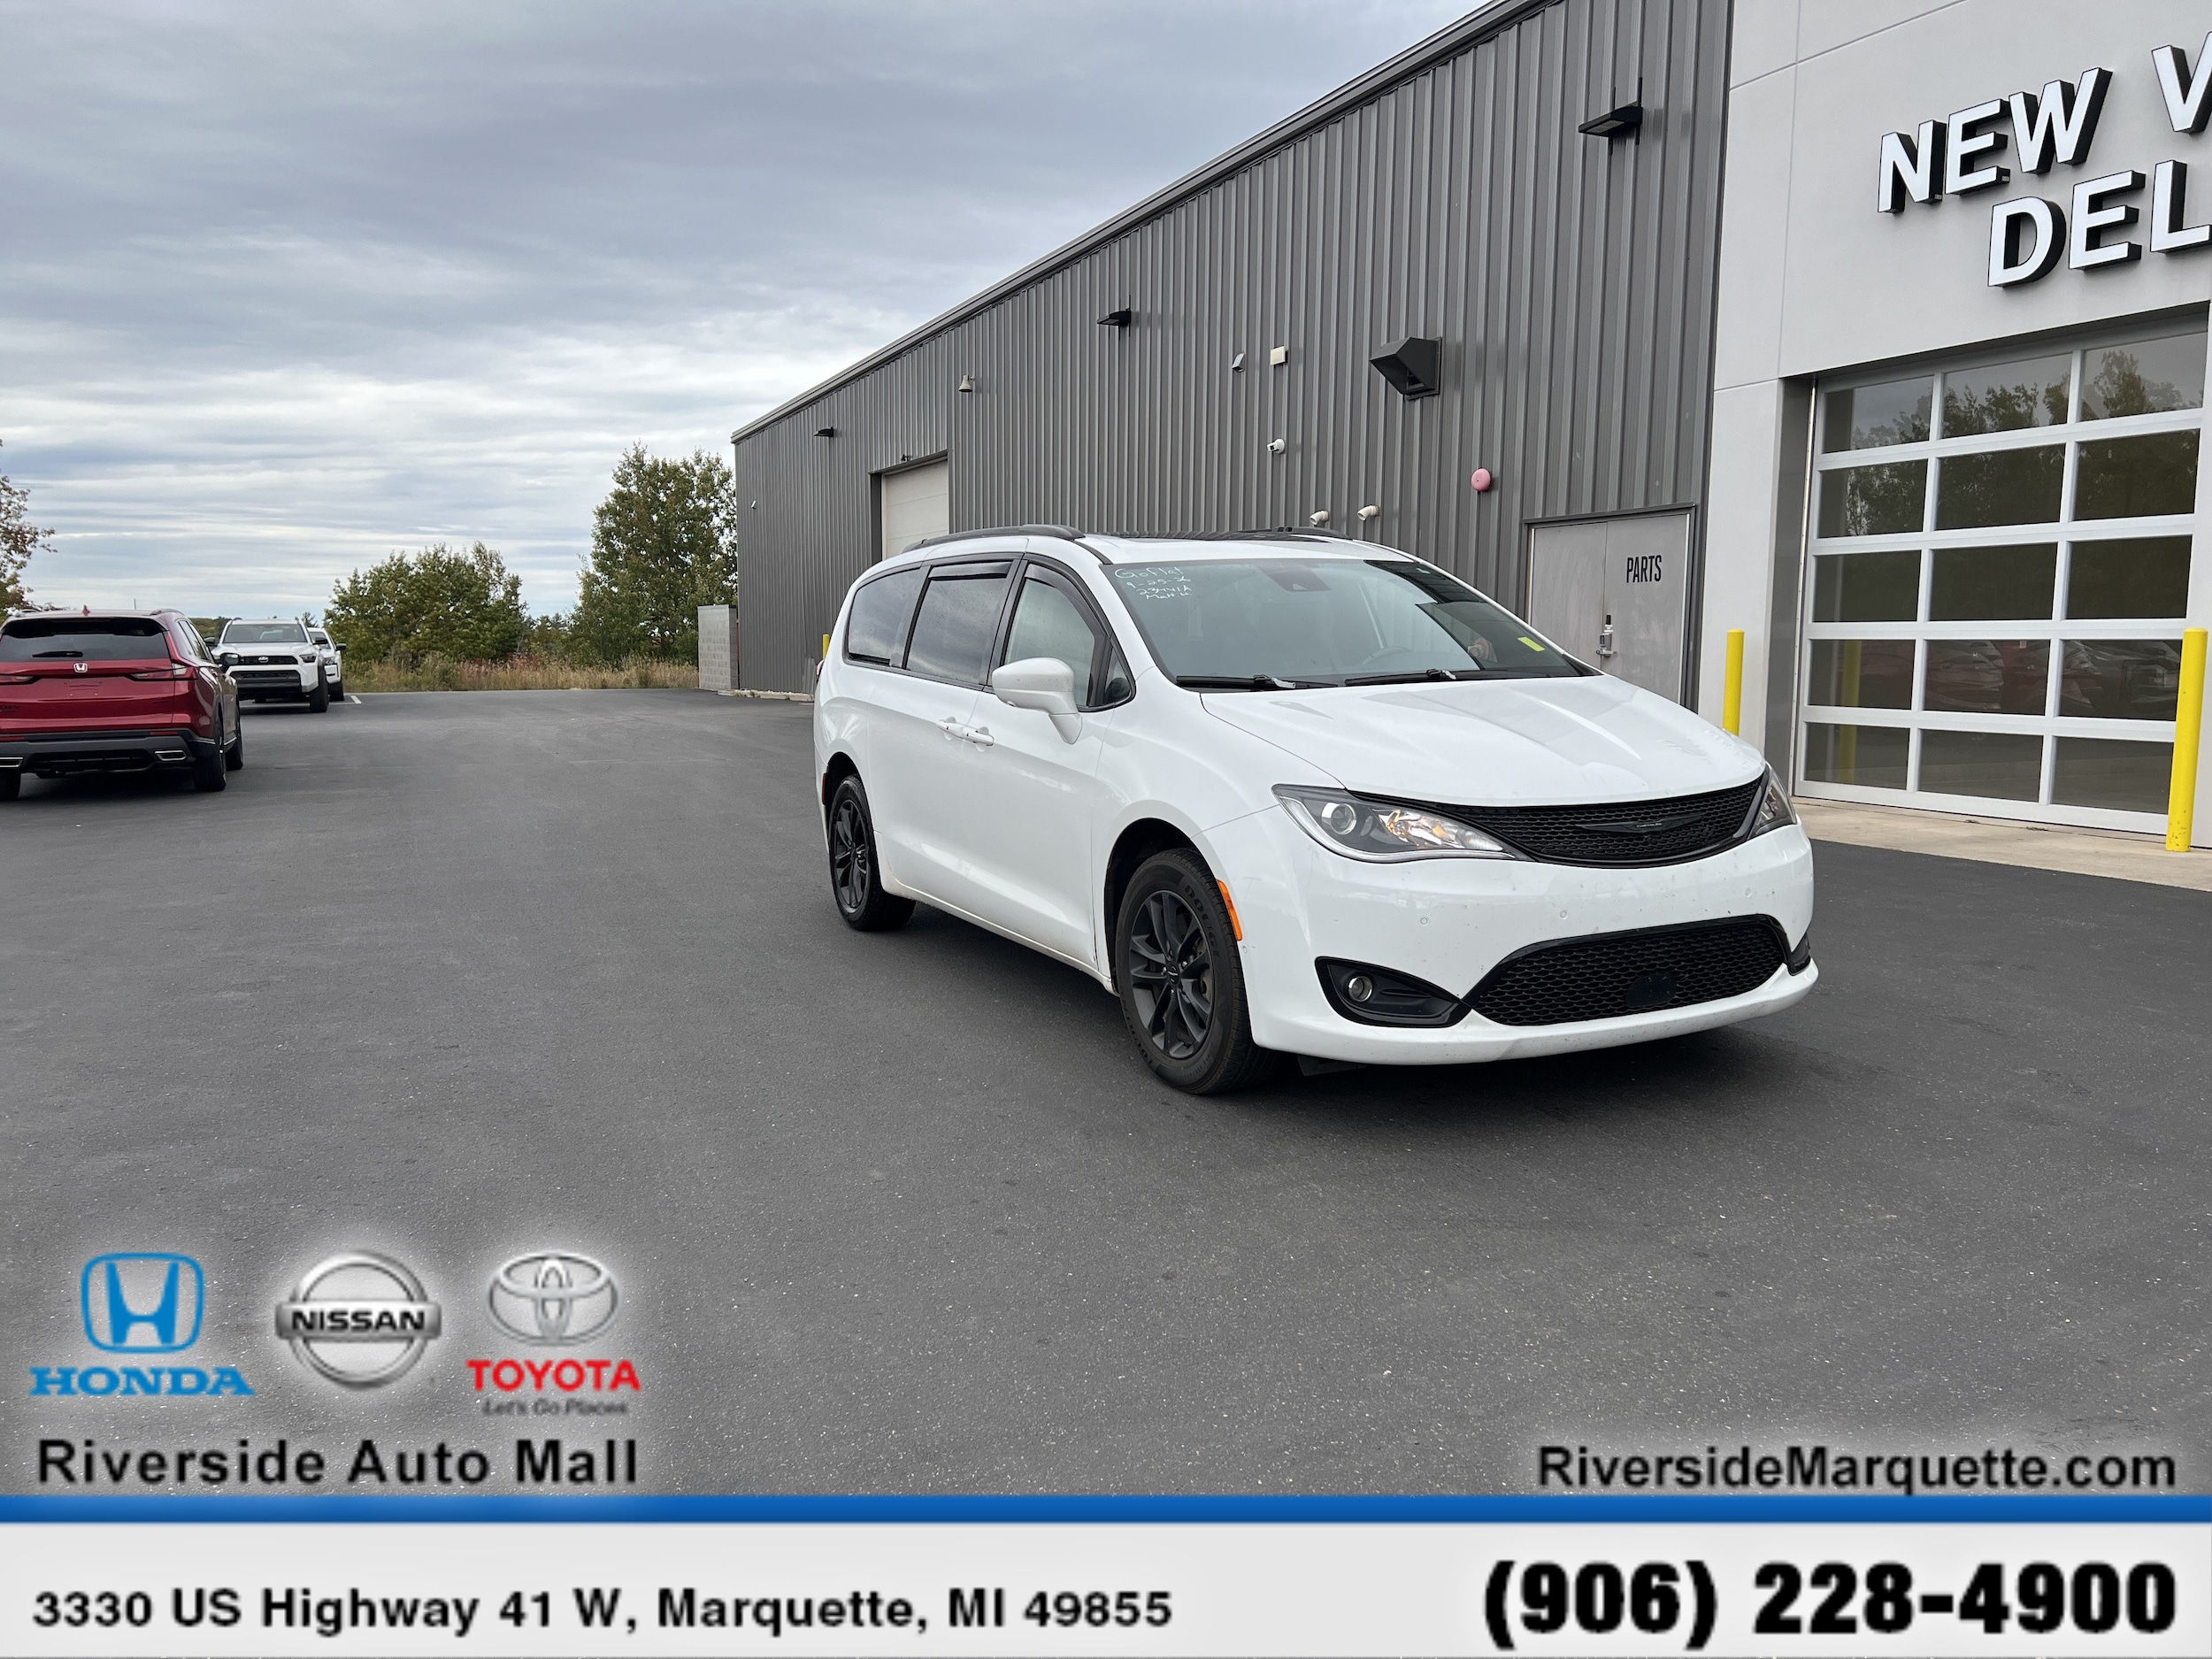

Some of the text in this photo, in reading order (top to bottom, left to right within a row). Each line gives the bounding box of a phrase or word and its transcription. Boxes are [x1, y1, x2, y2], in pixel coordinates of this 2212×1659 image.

[1878, 67, 2112, 214] NEW
[1987, 160, 2212, 288] DEL
[1626, 555, 1663, 583] PARTS
